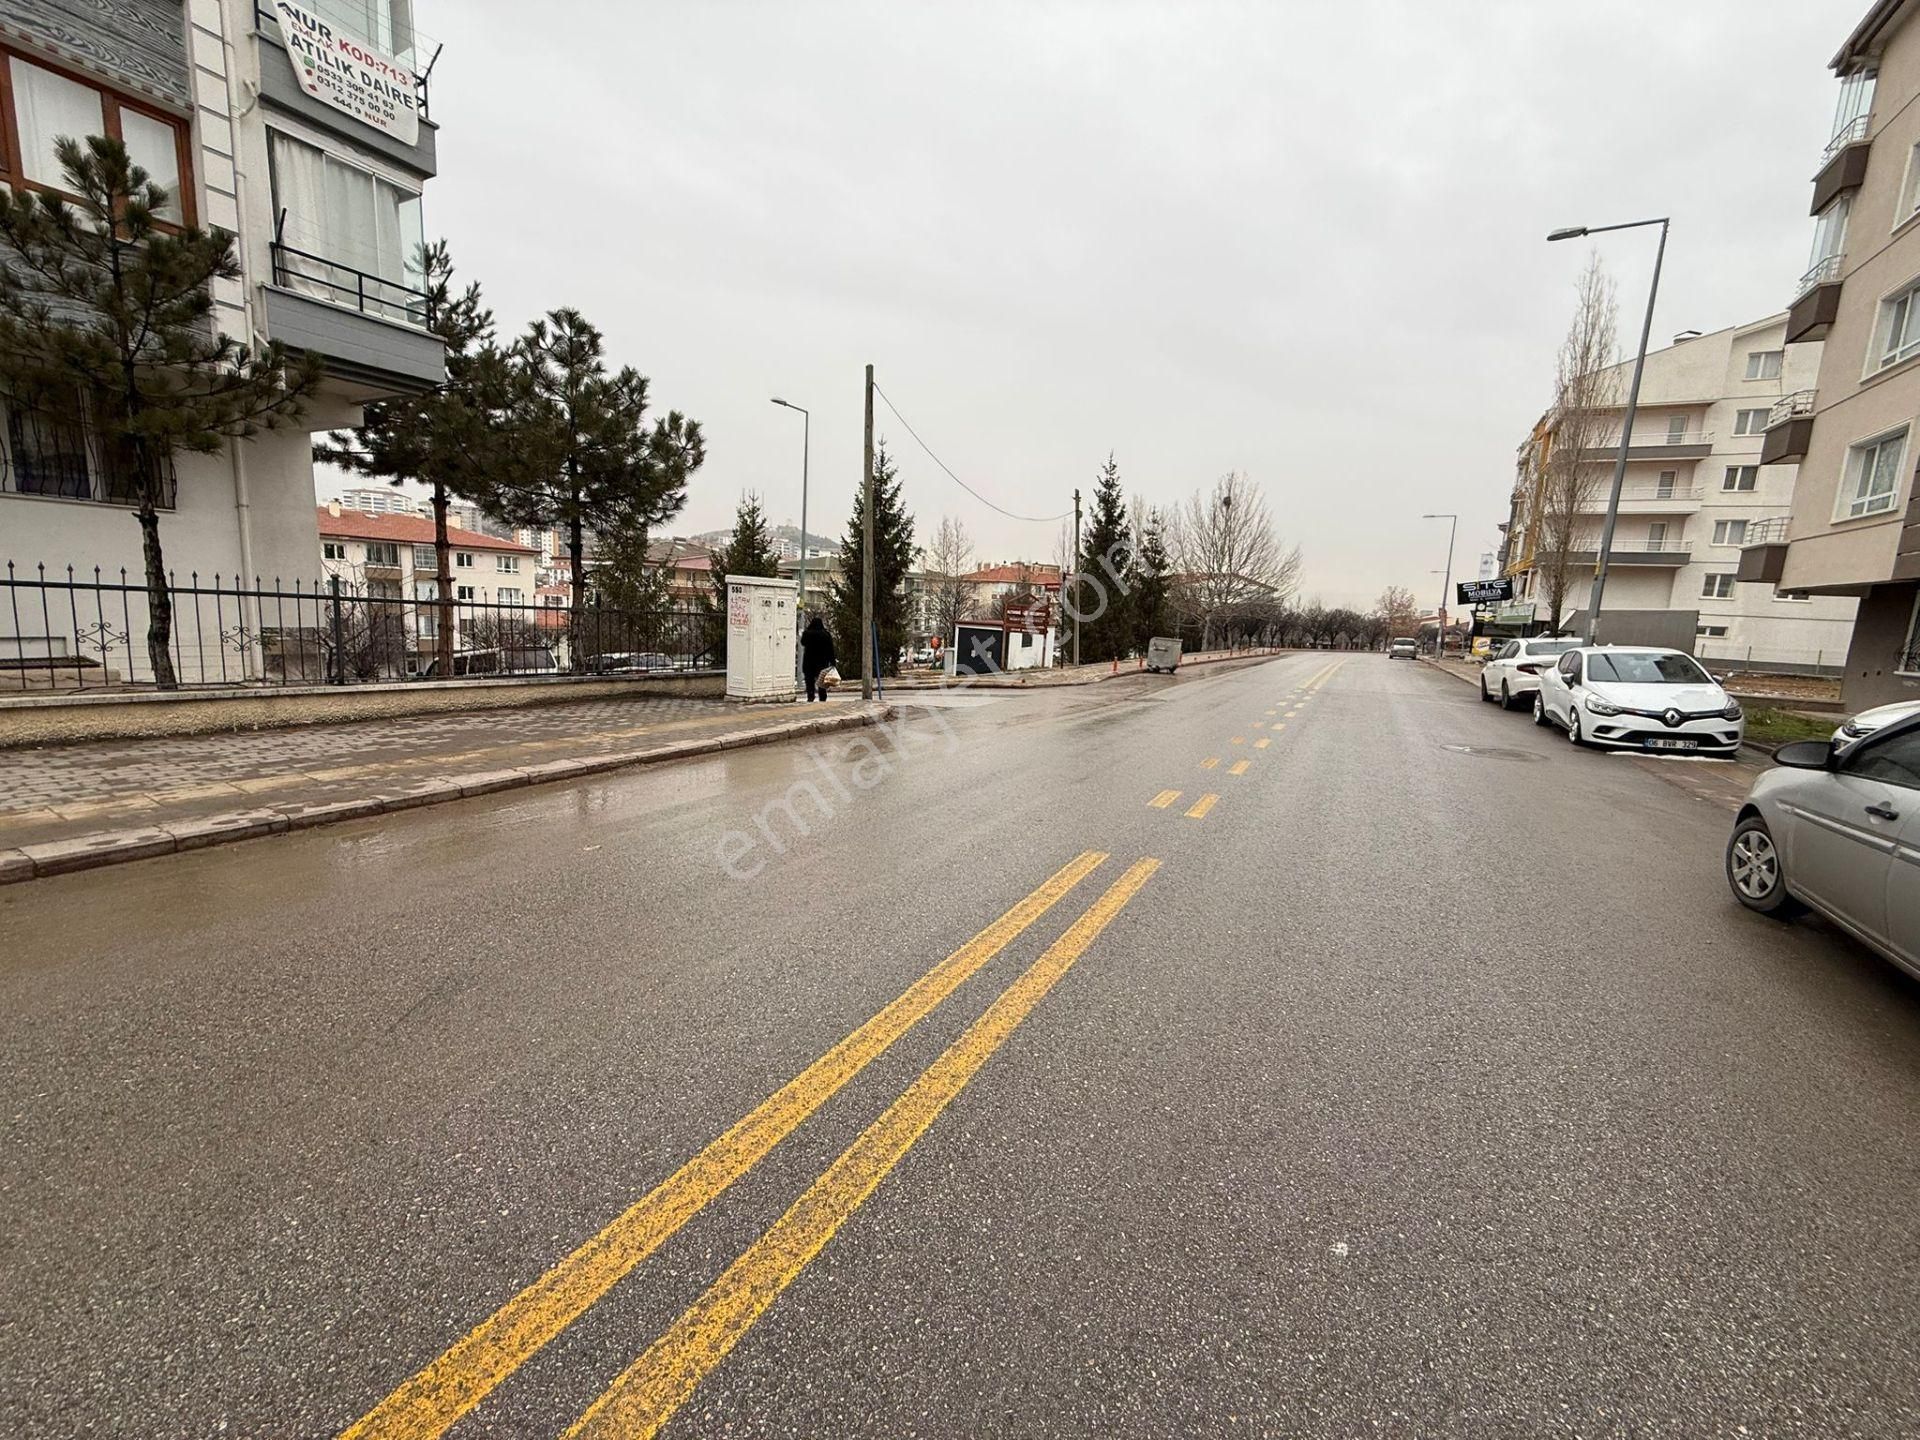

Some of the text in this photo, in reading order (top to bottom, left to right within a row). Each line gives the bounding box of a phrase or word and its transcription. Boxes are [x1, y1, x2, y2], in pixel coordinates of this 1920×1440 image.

[291, 21, 335, 53] EMLAK
[286, 29, 414, 110] ATILIK DAİRE
[339, 38, 408, 85] KOD:713
[317, 64, 343, 84] 0533
[367, 92, 379, 103] 41
[317, 75, 395, 121] 0312 375 00 00
[333, 96, 387, 127] 444 9 NUR
